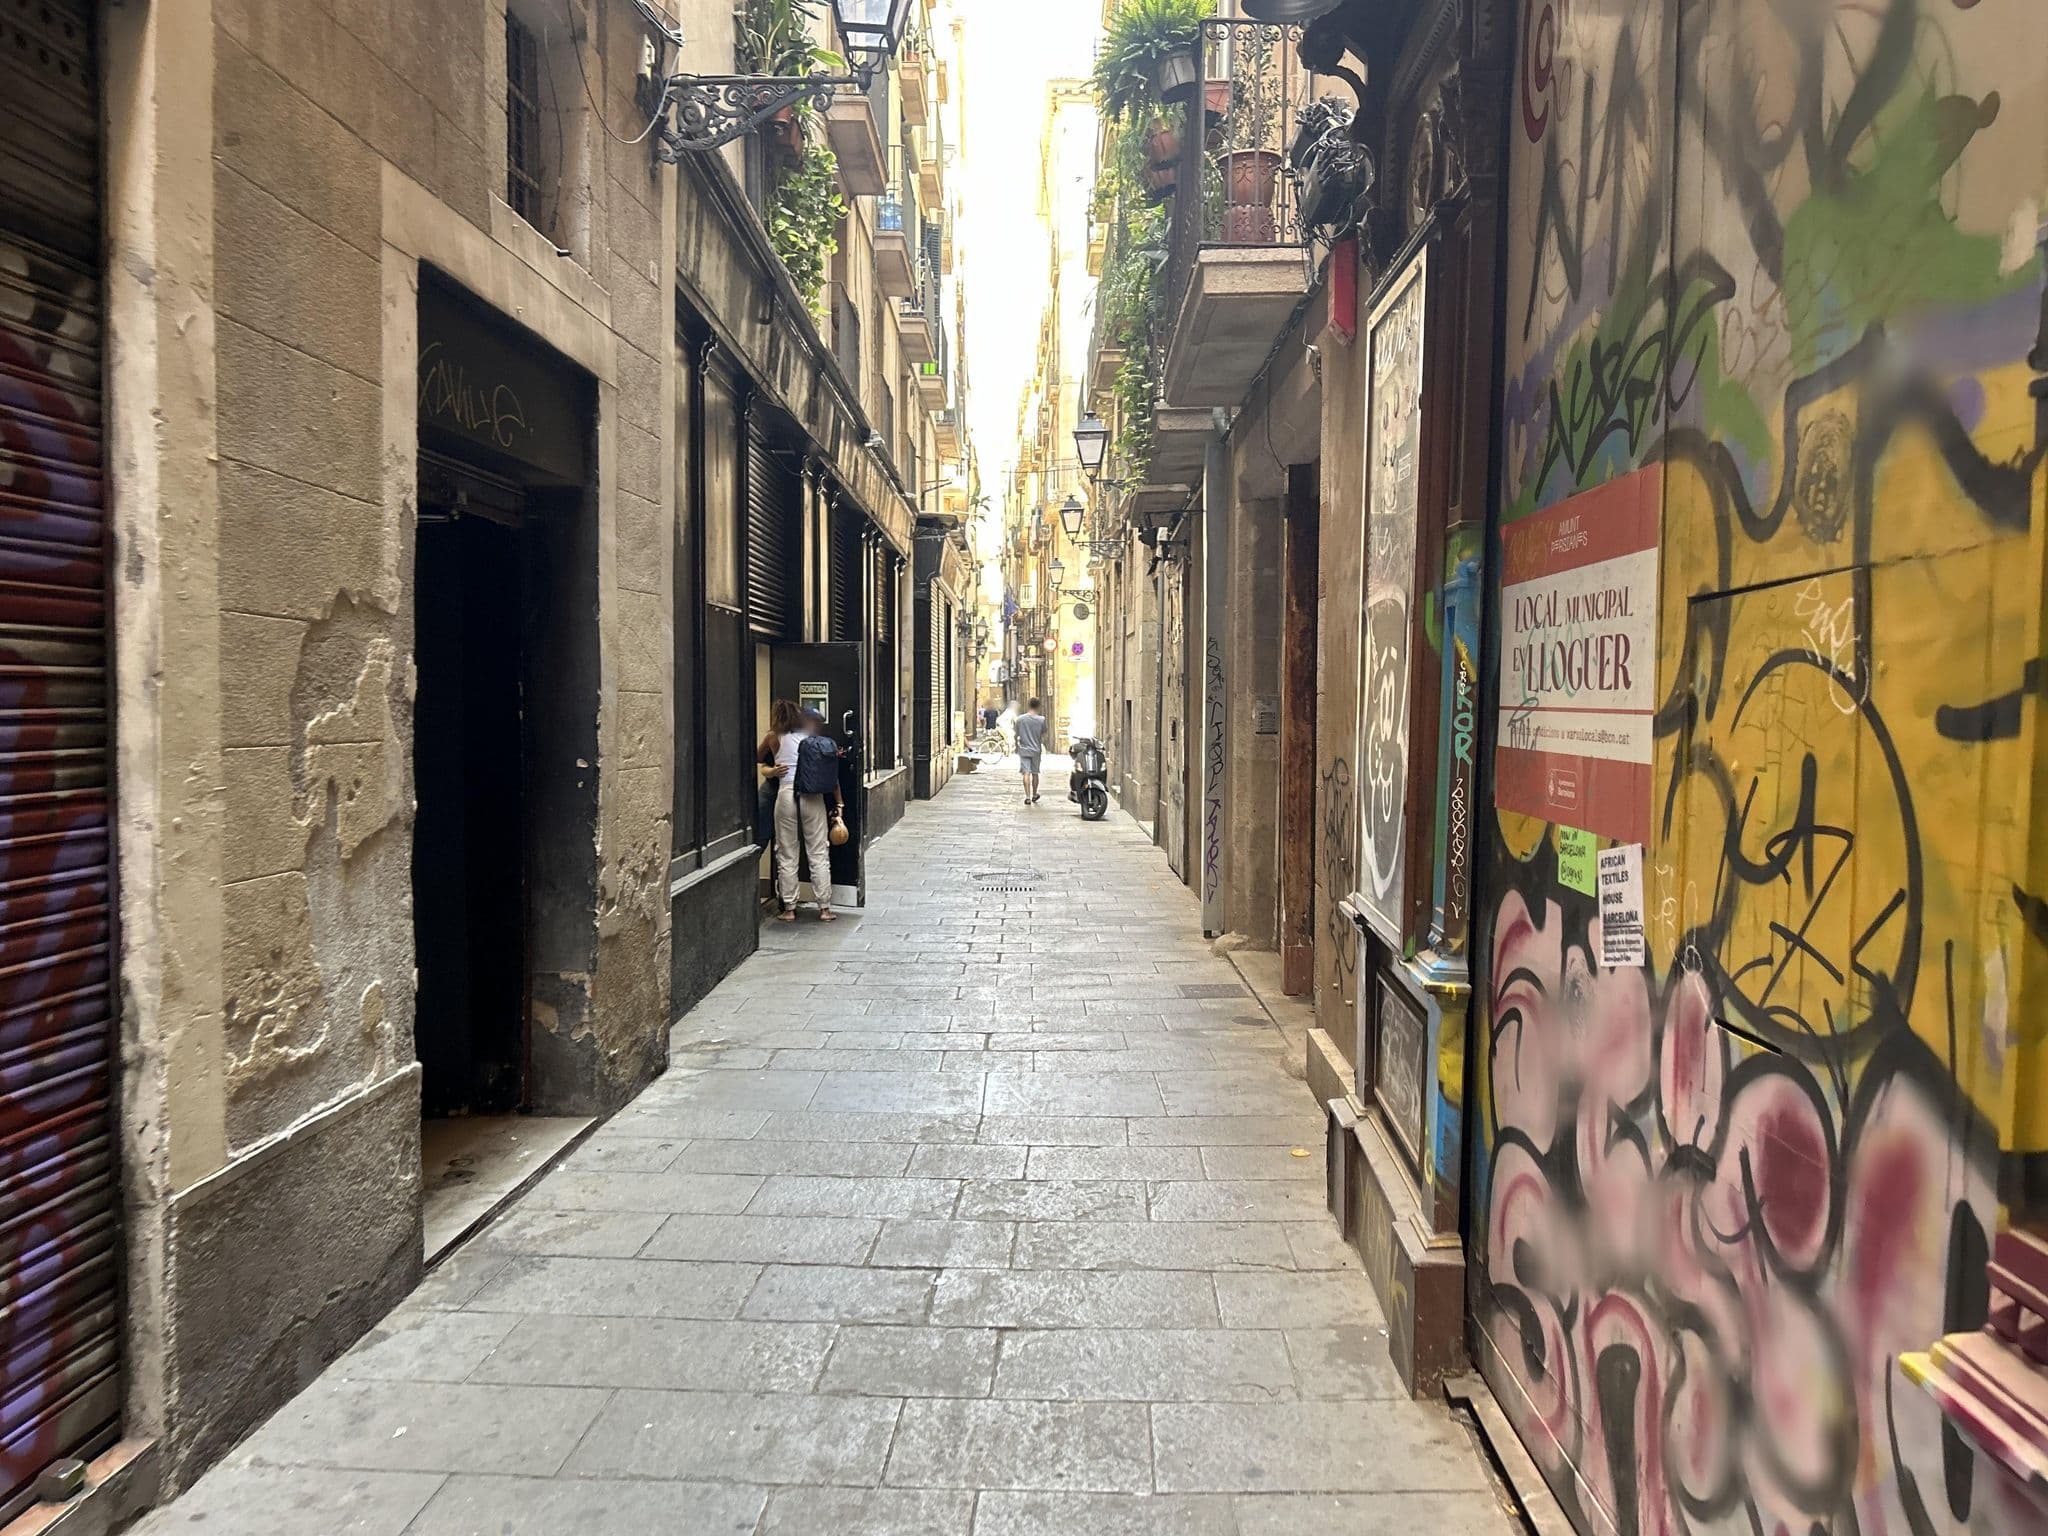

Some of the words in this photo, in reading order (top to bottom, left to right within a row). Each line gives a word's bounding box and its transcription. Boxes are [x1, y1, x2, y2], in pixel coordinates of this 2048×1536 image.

[1514, 590, 1562, 633] LOCAL
[1565, 586, 1633, 625] MUNICIPAL
[1512, 645, 1527, 672] EN
[1527, 633, 1632, 693] LLOGUER
[800, 685, 828, 694] SORTIDA
[1600, 854, 1626, 870] AFRICAN
[1601, 871, 1629, 886] TEXTILES
[1602, 892, 1624, 905] HOUSE
[1603, 910, 1639, 924] BARCELONA
